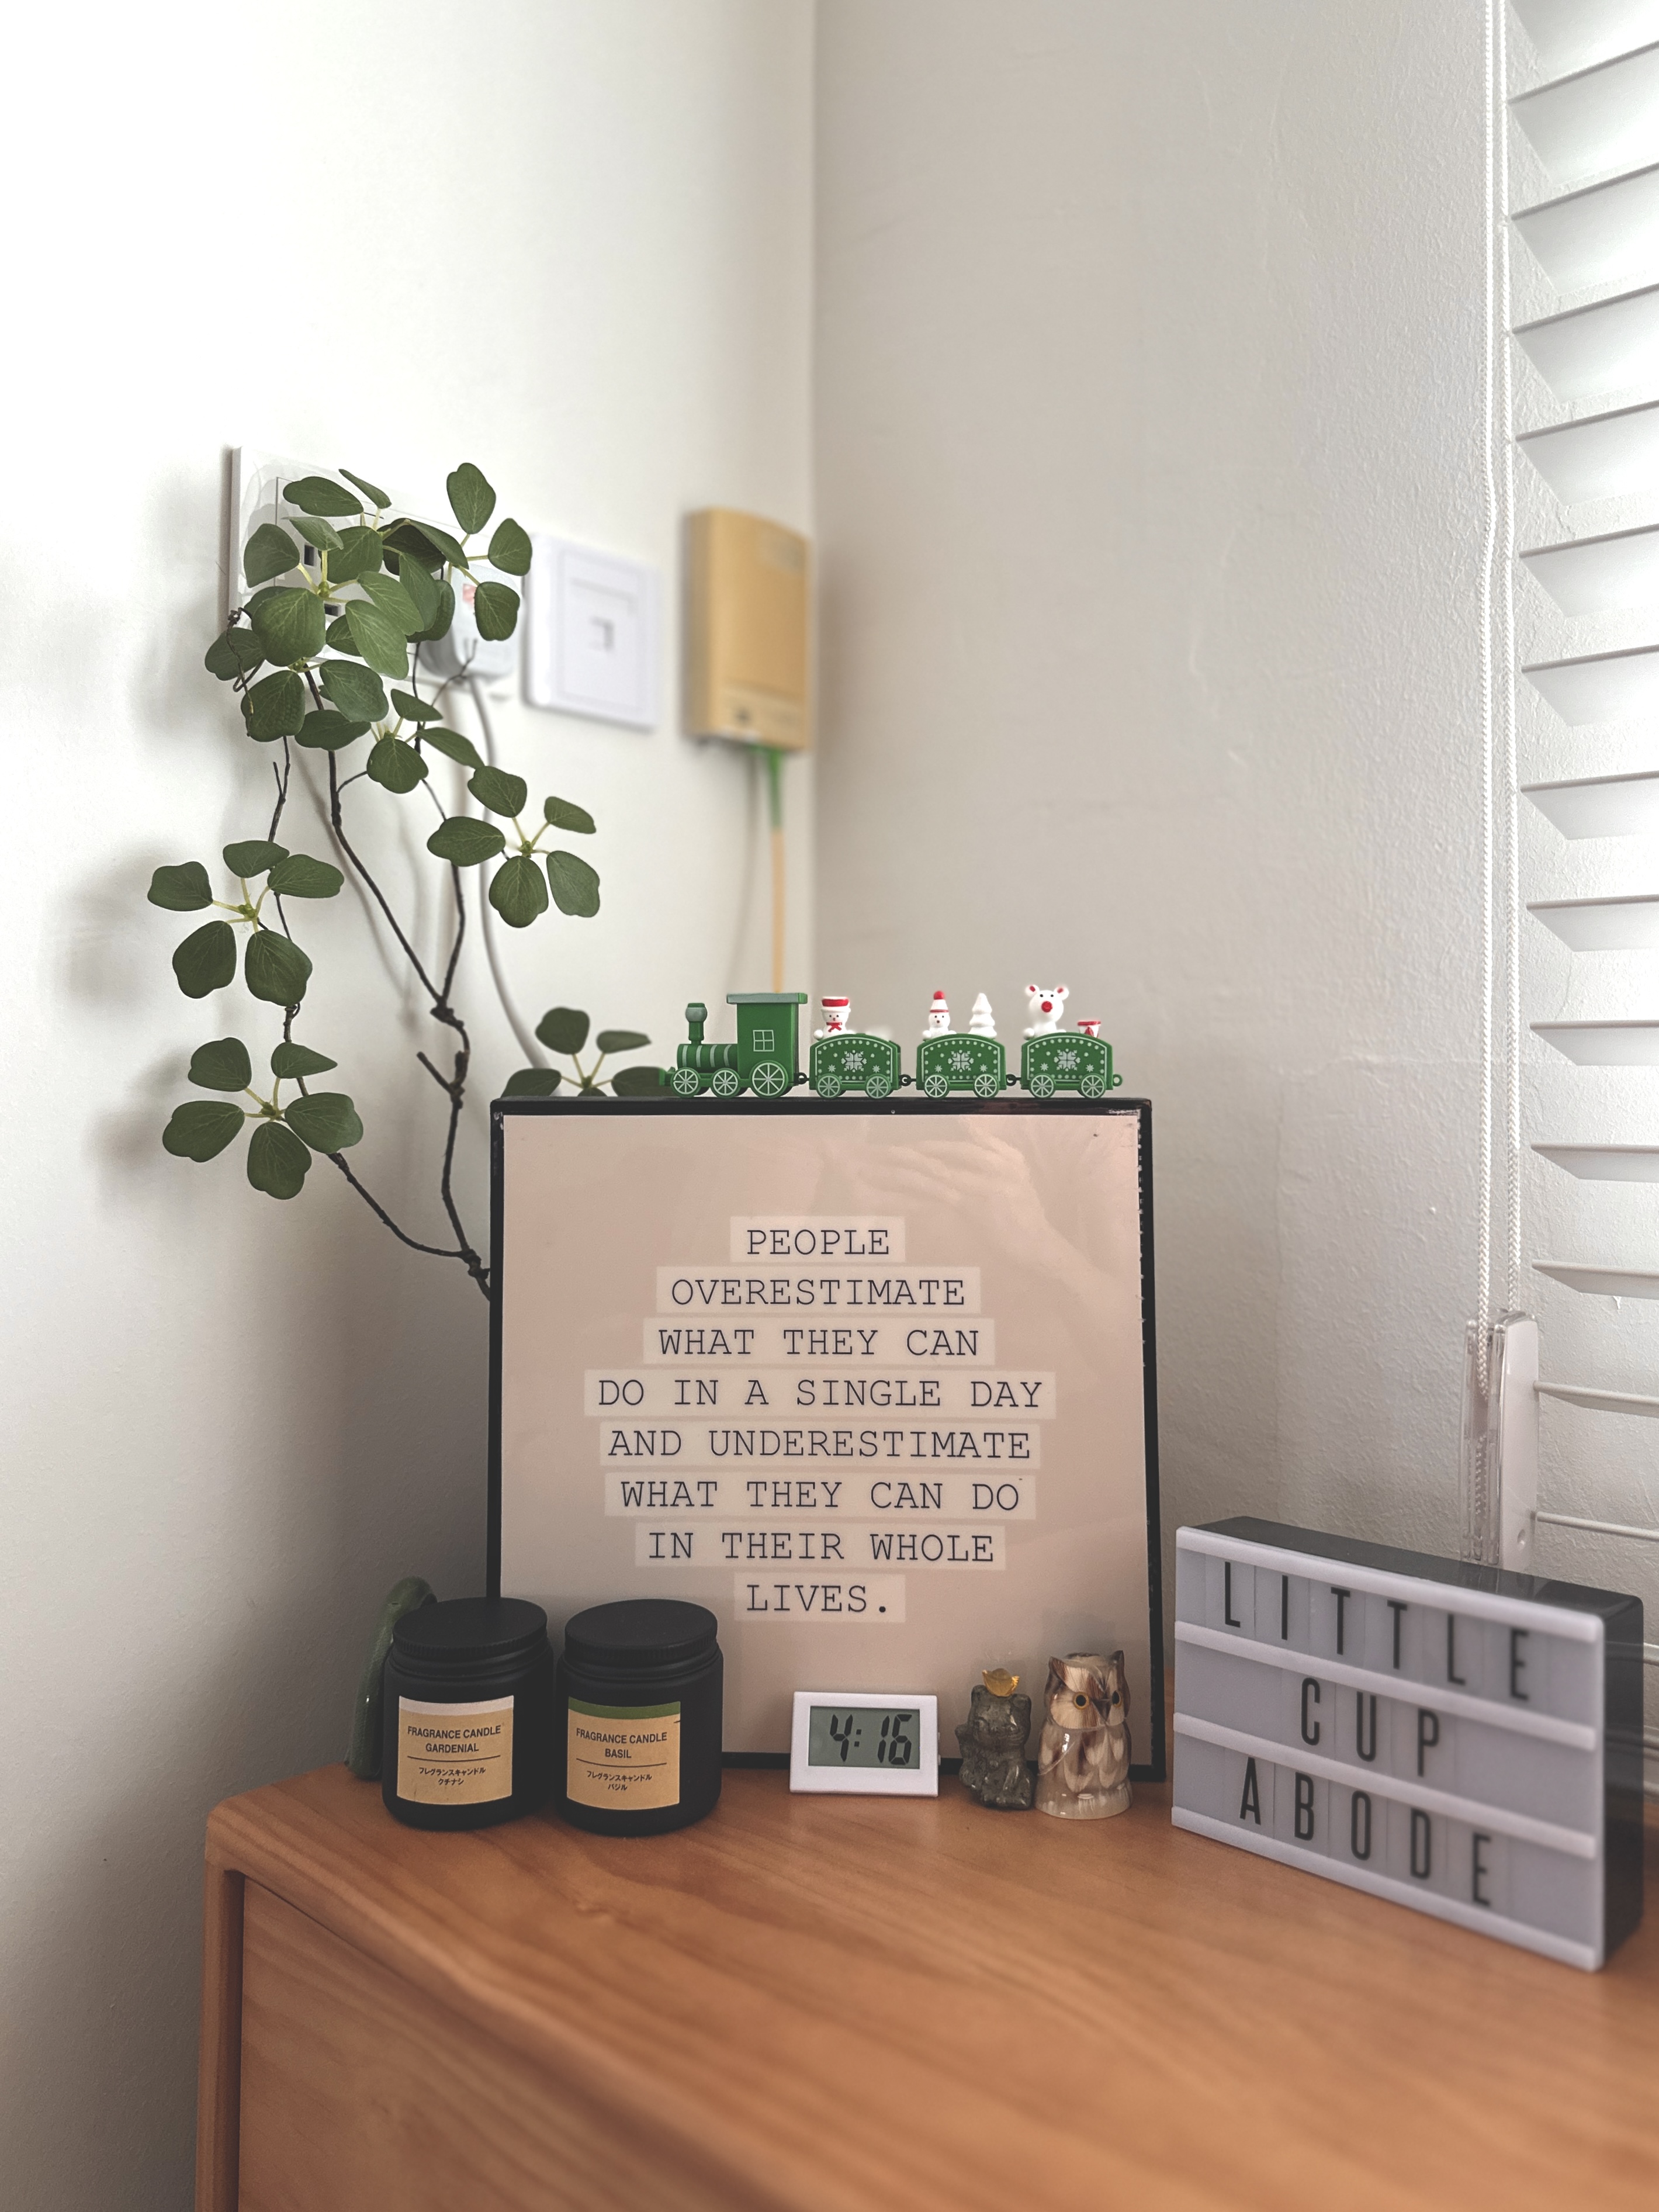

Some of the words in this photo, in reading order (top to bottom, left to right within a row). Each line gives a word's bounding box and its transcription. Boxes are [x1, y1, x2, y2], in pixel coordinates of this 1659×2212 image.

[747, 1230, 889, 1255] PEOPLE
[672, 1279, 964, 1305] OVERESTIMATE
[659, 1330, 754, 1354] WHAT
[784, 1330, 878, 1355] THEY
[907, 1330, 978, 1355] CAN
[599, 1380, 643, 1406] DO
[675, 1380, 718, 1404] IN
[744, 1380, 769, 1405] A
[797, 1380, 940, 1406] SINGLE
[971, 1382, 1042, 1407] DAY
[608, 1431, 681, 1456] AND
[709, 1431, 1029, 1458] UNDERESTIMATE
[621, 1481, 717, 1507] WHAT
[747, 1481, 842, 1507] THEY
[871, 1482, 943, 1508] CAN
[972, 1484, 1019, 1511] DO
[649, 1533, 693, 1558] IN
[722, 1533, 844, 1559] THEIR
[870, 1534, 993, 1562] WHOLE
[747, 1584, 886, 1612] LIVES.
[1224, 1562, 1529, 1701] LITTLE
[408, 1726, 460, 1739] FRAGRANCE
[463, 1725, 501, 1738] CANDLE
[576, 1728, 627, 1744] FRAGRANCE
[629, 1732, 667, 1744] CANDLE
[829, 1713, 912, 1765] 4:16
[1300, 1677, 1439, 1777] CUP
[425, 1743, 479, 1753] GARDENIAL
[605, 1748, 632, 1758] BASIL
[419, 1767, 486, 1776] フレグランスキャンドル
[587, 1770, 653, 1782] フレグランスキャンドル
[1239, 1757, 1491, 1907] ABODE
